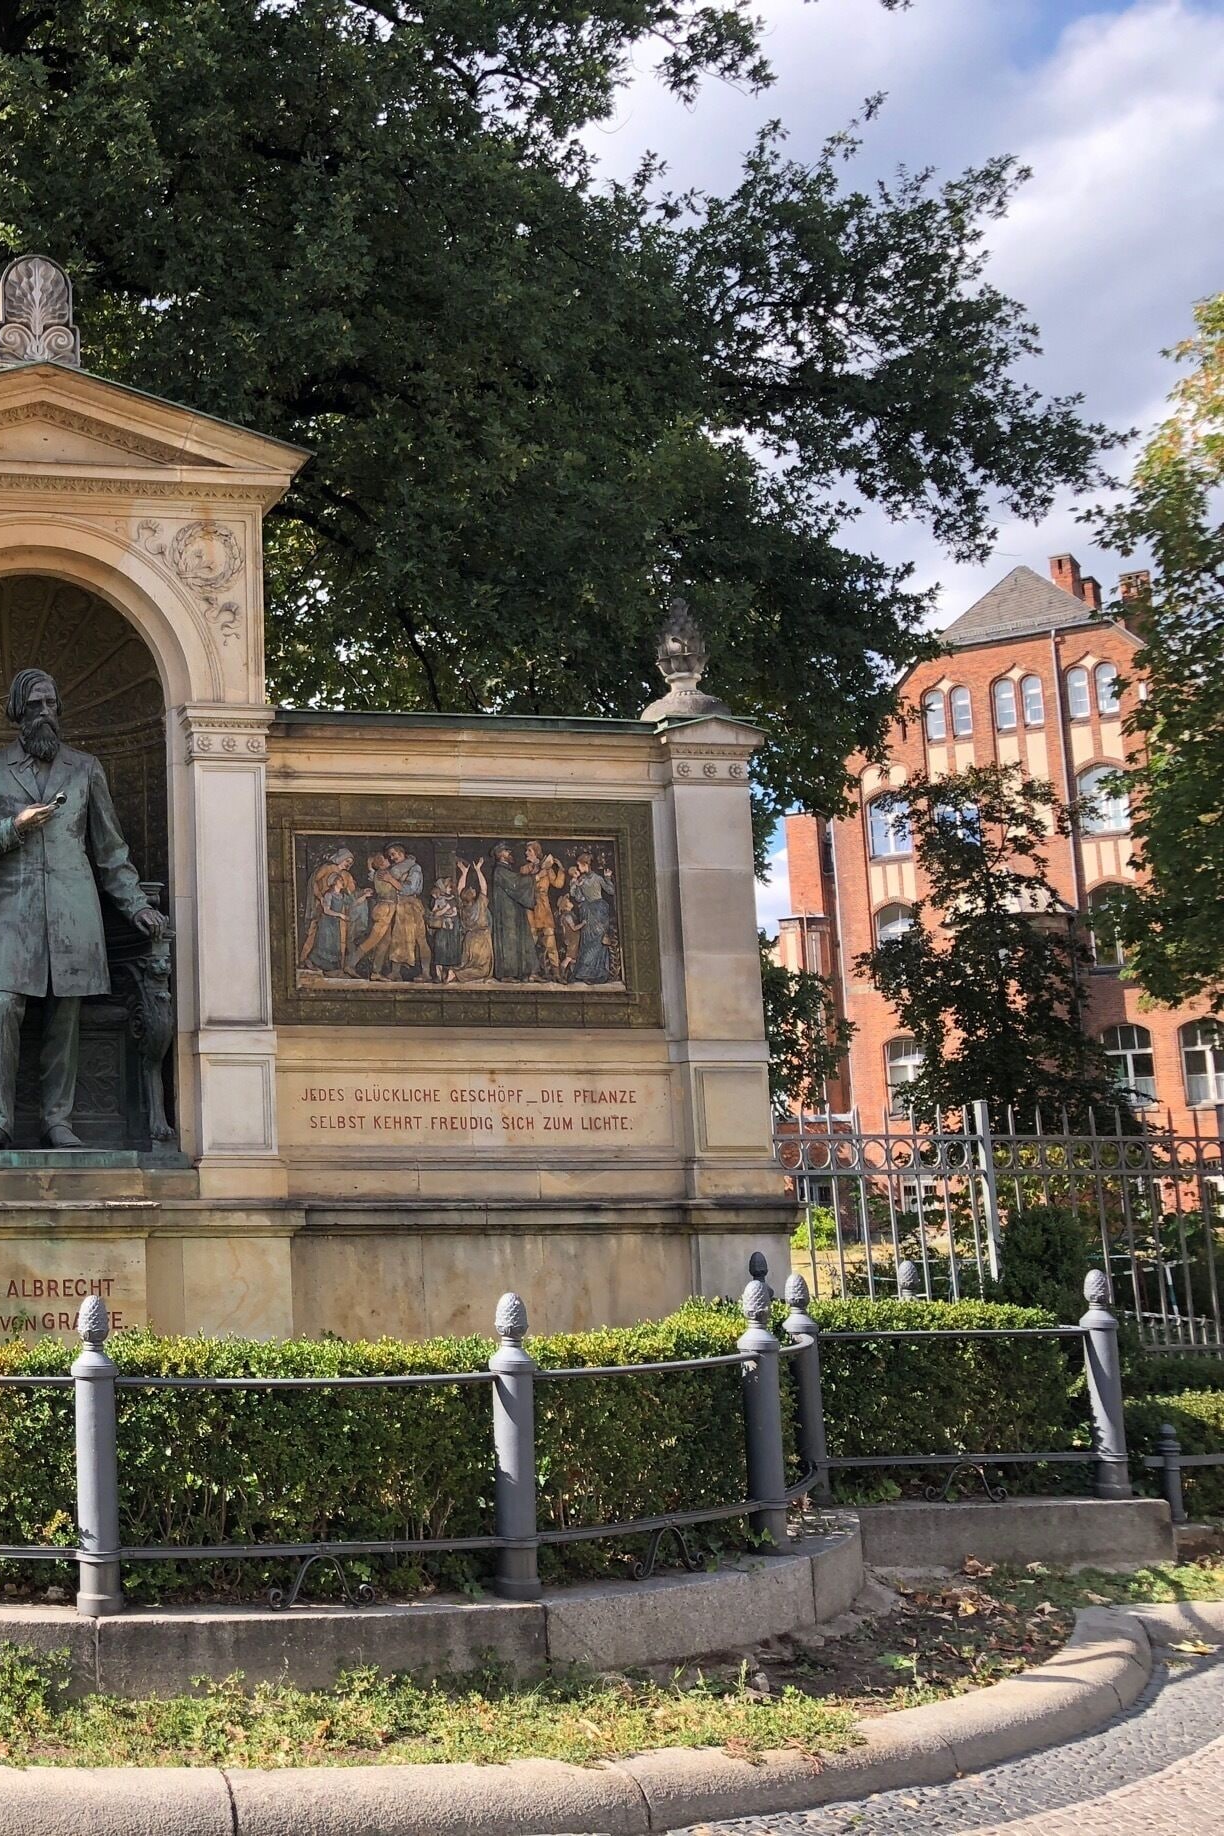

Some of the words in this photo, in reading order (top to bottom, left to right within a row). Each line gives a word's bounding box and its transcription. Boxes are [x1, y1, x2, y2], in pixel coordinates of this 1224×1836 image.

[301, 1089, 345, 1103] JEDES
[354, 1084, 441, 1103] GLÜCKLICHE
[450, 1085, 524, 1103] GESCHÖPF
[541, 1089, 564, 1103] DIE
[574, 1089, 637, 1104] PFLANZE
[310, 1115, 366, 1130] SELBST
[373, 1115, 423, 1130] KEHRT
[430, 1116, 494, 1131] FREUDIG
[502, 1116, 535, 1131] SICH
[543, 1116, 573, 1131] ZUM
[6, 1279, 115, 1298] ALBRECHT
[42, 1311, 128, 1330] GRAE.
